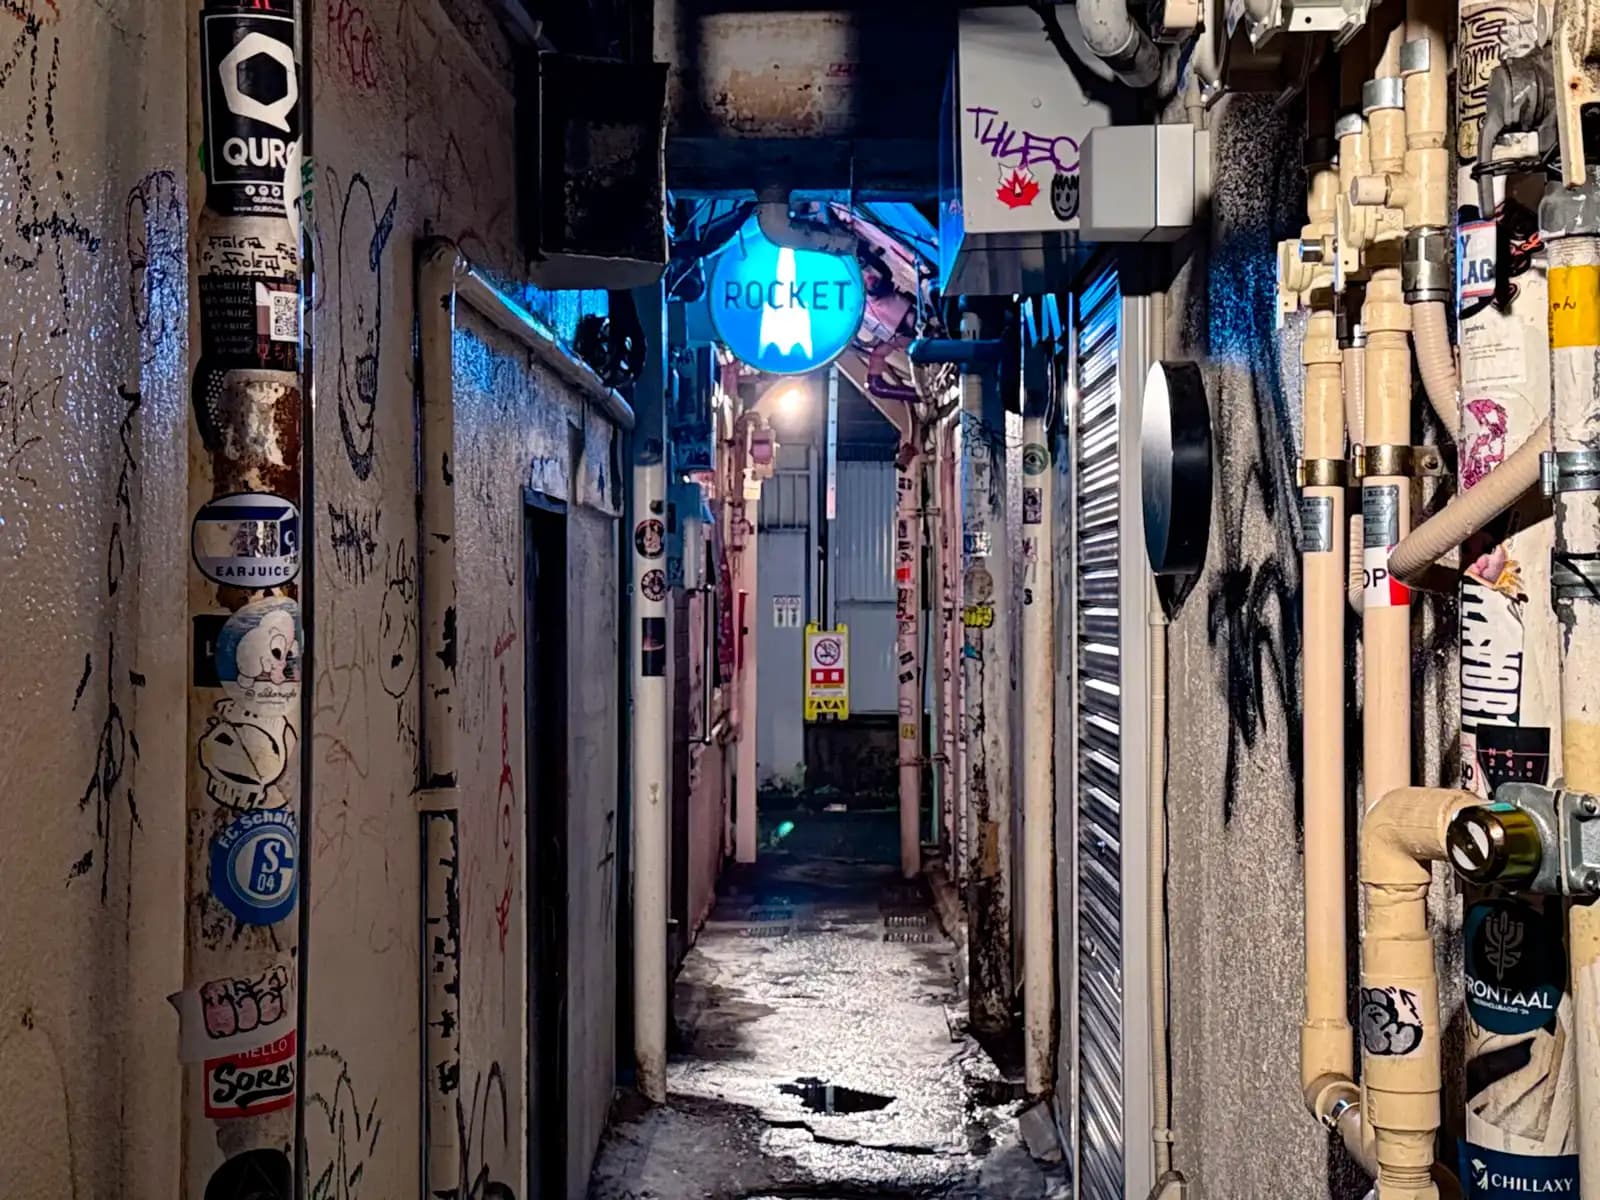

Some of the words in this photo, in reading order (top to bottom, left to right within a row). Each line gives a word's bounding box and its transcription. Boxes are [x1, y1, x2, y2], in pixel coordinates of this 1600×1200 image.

[724, 280, 851, 310] ROCKET
[215, 566, 290, 577] EARJUICE
[1491, 1173, 1573, 1192] CHILLAXY
